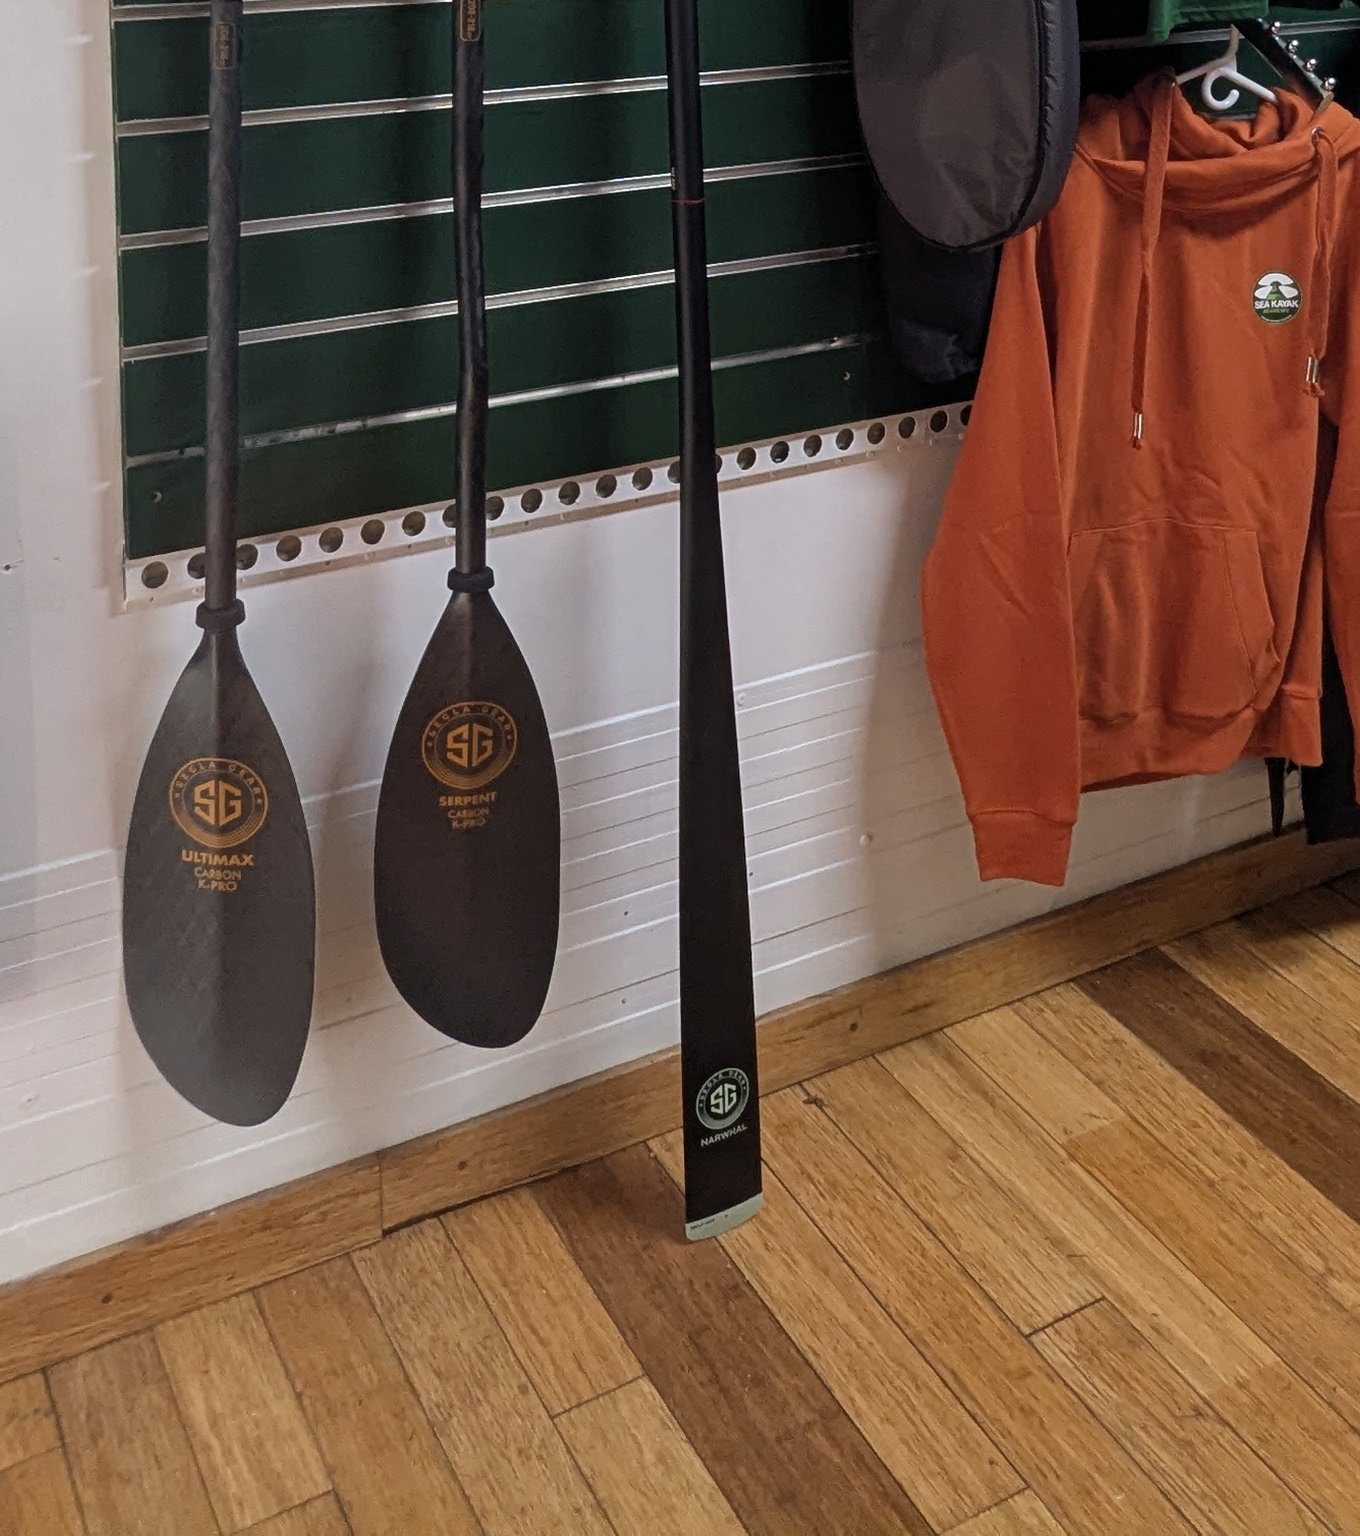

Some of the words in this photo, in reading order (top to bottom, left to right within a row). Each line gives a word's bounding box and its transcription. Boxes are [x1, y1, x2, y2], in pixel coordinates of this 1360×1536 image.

[1254, 300, 1270, 310] SEA
[1271, 299, 1299, 309] KAYAK
[447, 723, 493, 768] SG
[194, 779, 242, 826] SG
[438, 792, 497, 806] SERPENT
[448, 807, 489, 819] CARBON
[182, 849, 254, 866] ULTIMAX
[194, 867, 242, 881] CARBON
[198, 880, 237, 891] K-PRO
[710, 1083, 737, 1114] SG
[700, 1124, 748, 1147] NARWHAL
